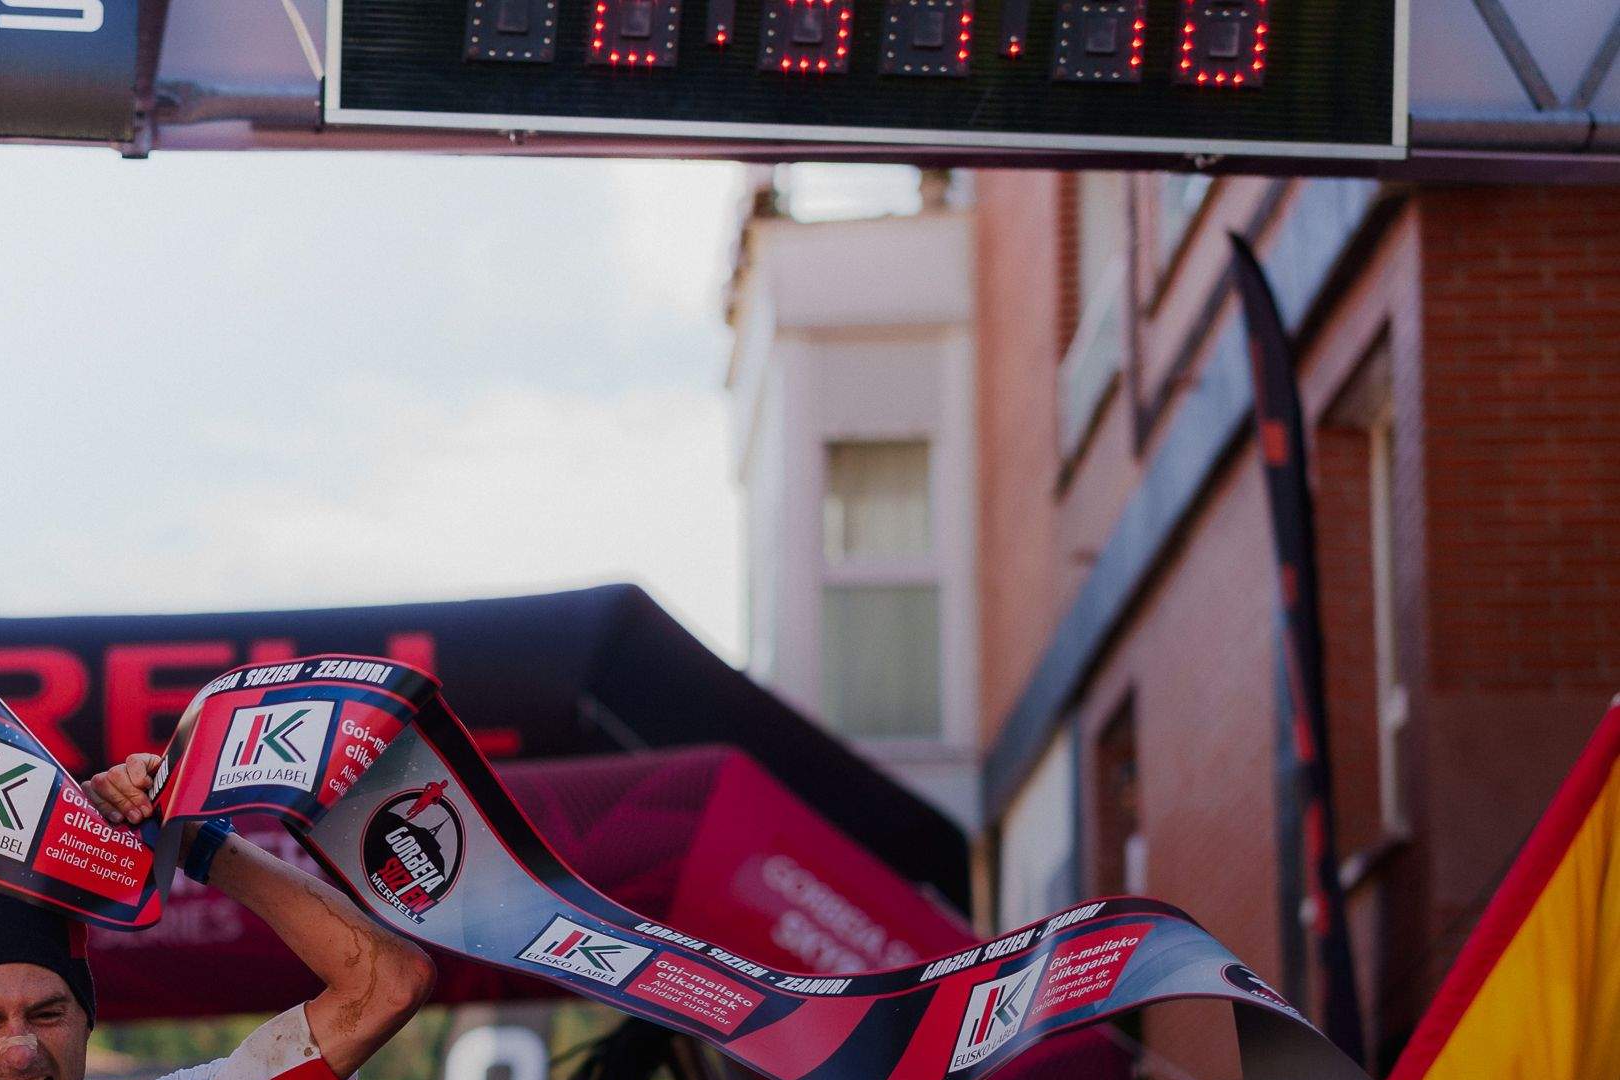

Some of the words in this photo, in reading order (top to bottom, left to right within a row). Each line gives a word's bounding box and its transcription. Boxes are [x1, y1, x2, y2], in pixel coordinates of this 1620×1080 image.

[245, 663, 304, 687] SUZIEN
[312, 660, 393, 684] ZEANURI
[218, 769, 264, 786] EUSKO
[266, 769, 310, 786] LABEL
[58, 831, 117, 864] Alimentos
[120, 856, 135, 870] de
[63, 811, 143, 853] elikagaiak
[45, 846, 87, 870] calidad
[91, 862, 138, 889] superior
[385, 826, 445, 894] GORBEIA
[370, 872, 422, 924] MERRELL
[634, 921, 707, 951] GORBEIA
[707, 947, 770, 980] SUZIEN
[774, 976, 853, 995] ZEANURI
[919, 947, 982, 983] GORBEIA
[981, 928, 1035, 962] SUZIEN
[1040, 902, 1107, 940] ZEANURI
[1049, 936, 1139, 971] Goi-mailako
[526, 952, 573, 969] EUSKO
[574, 964, 617, 984] LABEL
[655, 960, 753, 1008] Goi-mailako
[1043, 974, 1092, 999] Alimentos
[1096, 968, 1110, 979] de
[1048, 951, 1121, 984] elikagaiak
[638, 983, 682, 1004] calidad
[682, 1000, 731, 1025] superior
[650, 979, 711, 1008] Alimentos
[712, 1005, 728, 1016] de
[656, 970, 739, 1012] elikagaiak
[1031, 996, 1066, 1016] calidad
[1068, 979, 1112, 1001] superior
[953, 1044, 990, 1068] EUSKO
[990, 1025, 1018, 1051] LABEL
